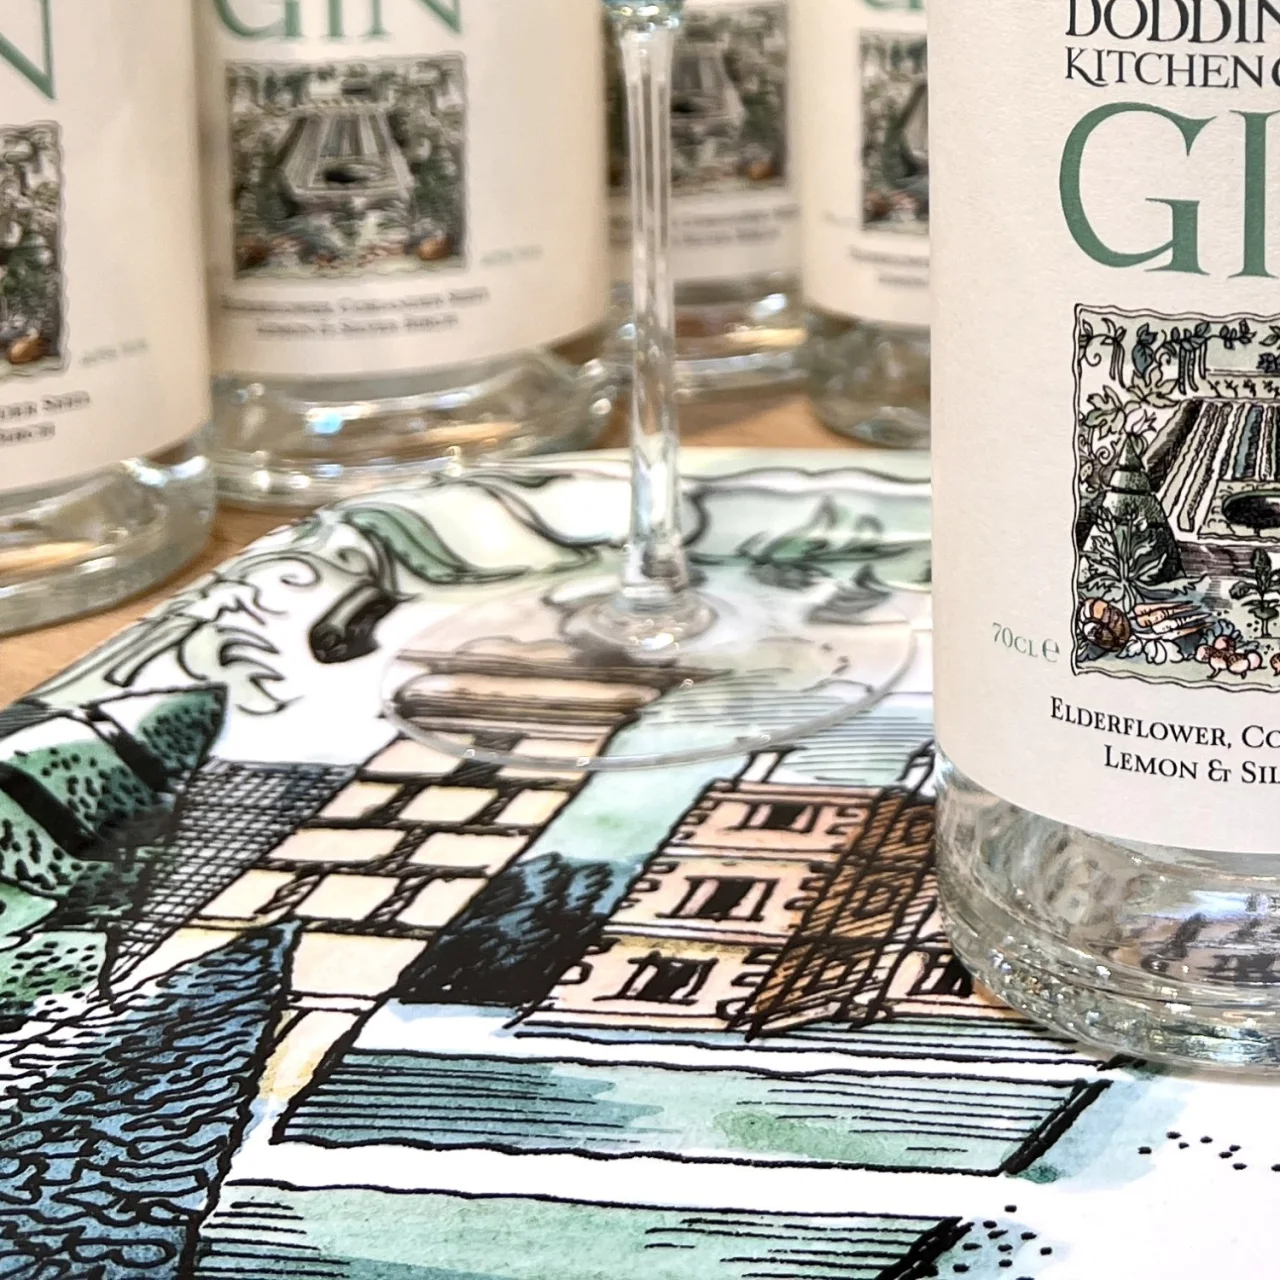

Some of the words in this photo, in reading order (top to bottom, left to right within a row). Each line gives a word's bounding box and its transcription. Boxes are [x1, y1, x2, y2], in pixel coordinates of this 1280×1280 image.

[1050, 695, 1232, 750] ELDERFLOWER,
[1103, 744, 1198, 780] LEMON
[1207, 758, 1232, 783] &
